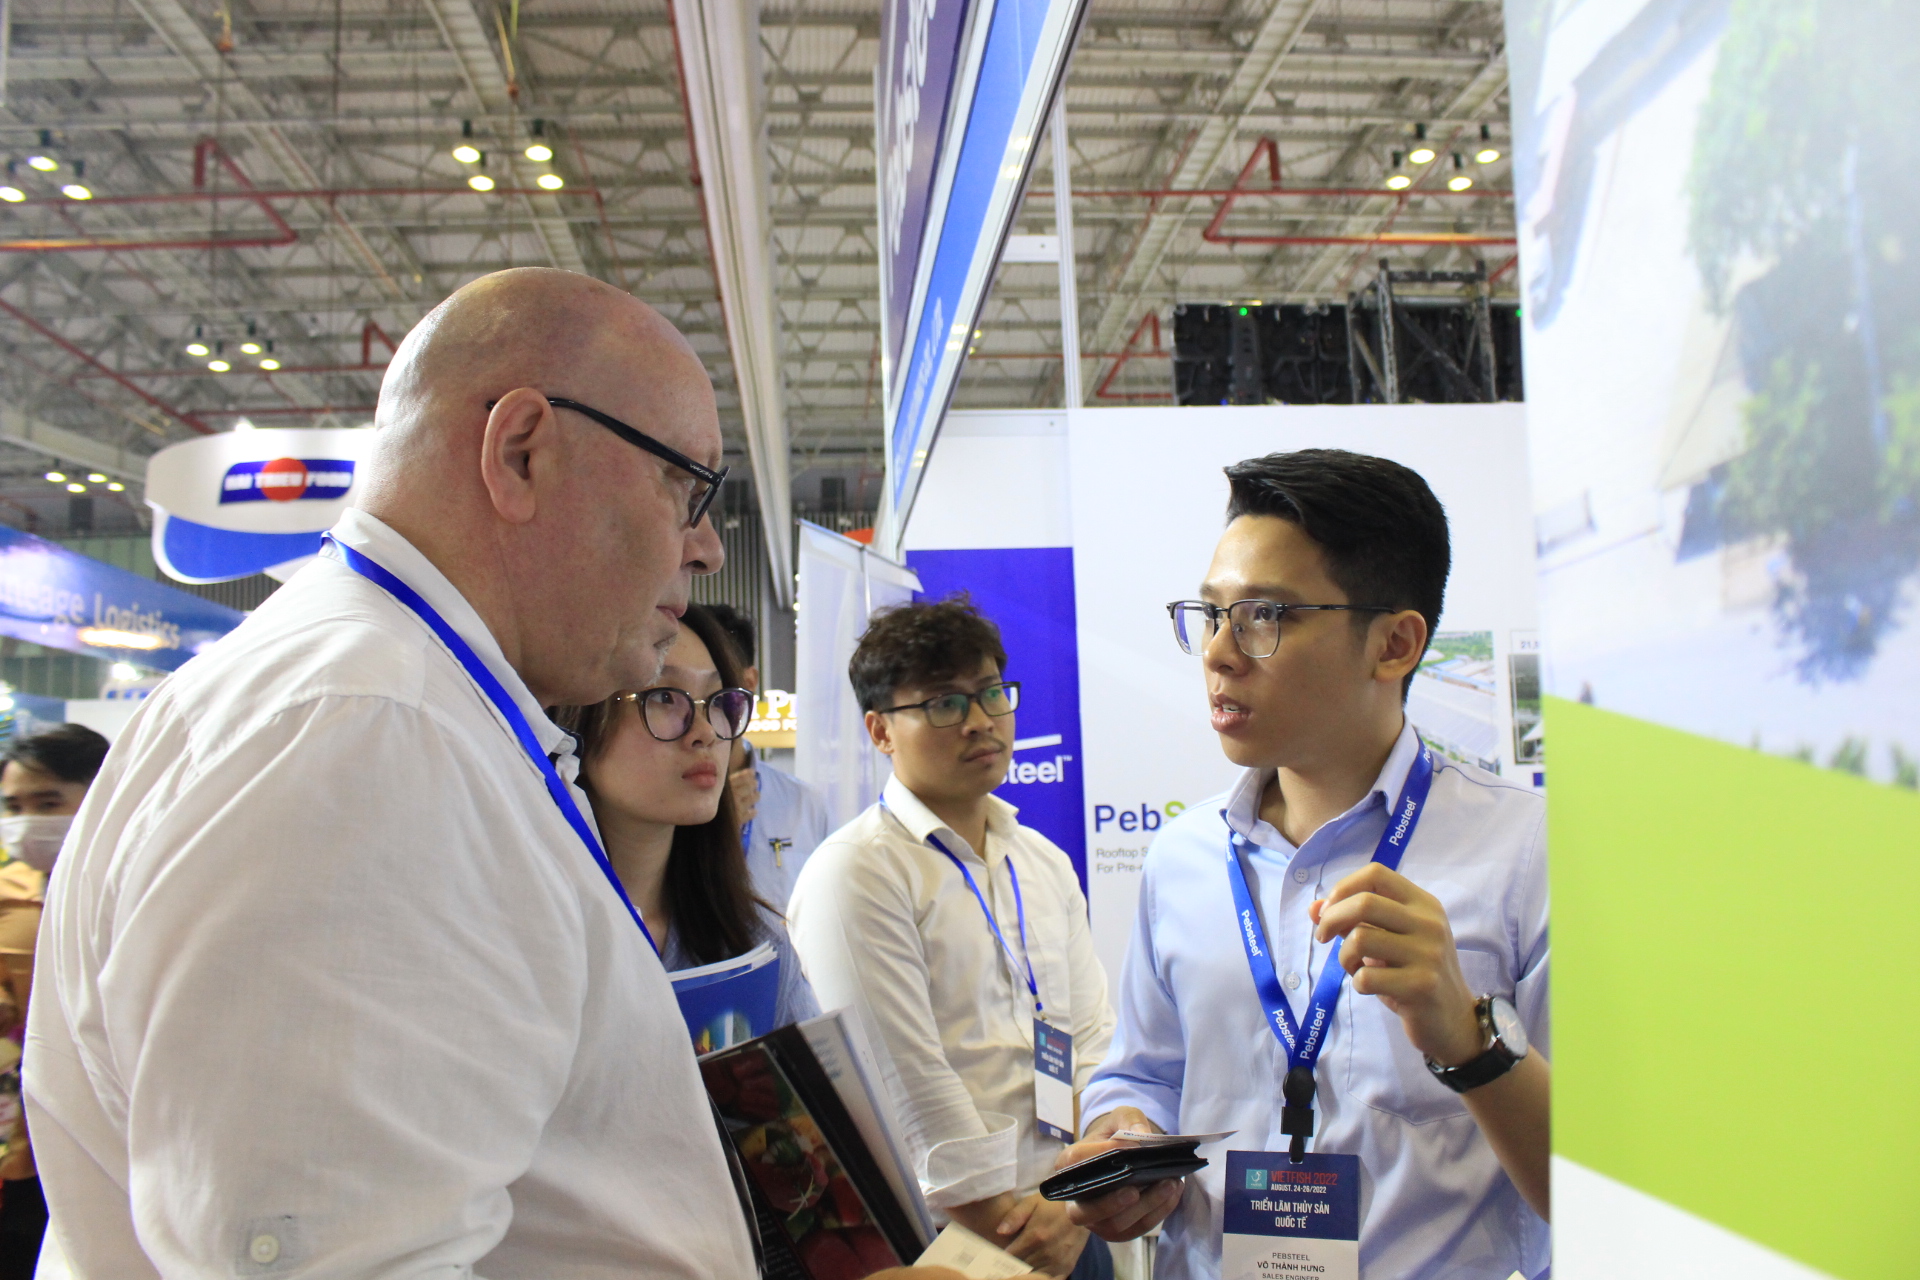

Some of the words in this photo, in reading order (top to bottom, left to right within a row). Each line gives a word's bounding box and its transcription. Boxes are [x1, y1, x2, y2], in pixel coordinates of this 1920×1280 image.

[1094, 801, 1186, 833] PebS
[1096, 847, 1138, 858] Rooftop
[1096, 863, 1113, 874] For
[1270, 1170, 1312, 1184] VIETFISH
[1313, 1173, 1338, 1186] 2022
[1270, 1183, 1293, 1192] AUGUST.
[1250, 1197, 1273, 1211] TRIỂN
[1293, 1200, 1313, 1214] THỦY
[1314, 1202, 1330, 1214] SẢN
[1275, 1215, 1296, 1228] QUỐC
[1297, 1216, 1308, 1228] TẾ
[1272, 1252, 1310, 1261] PEBSTEEL
[1271, 1262, 1299, 1271] THÀNH
[1300, 1264, 1325, 1273] HƯNG
[1262, 1272, 1284, 1280] SALES
